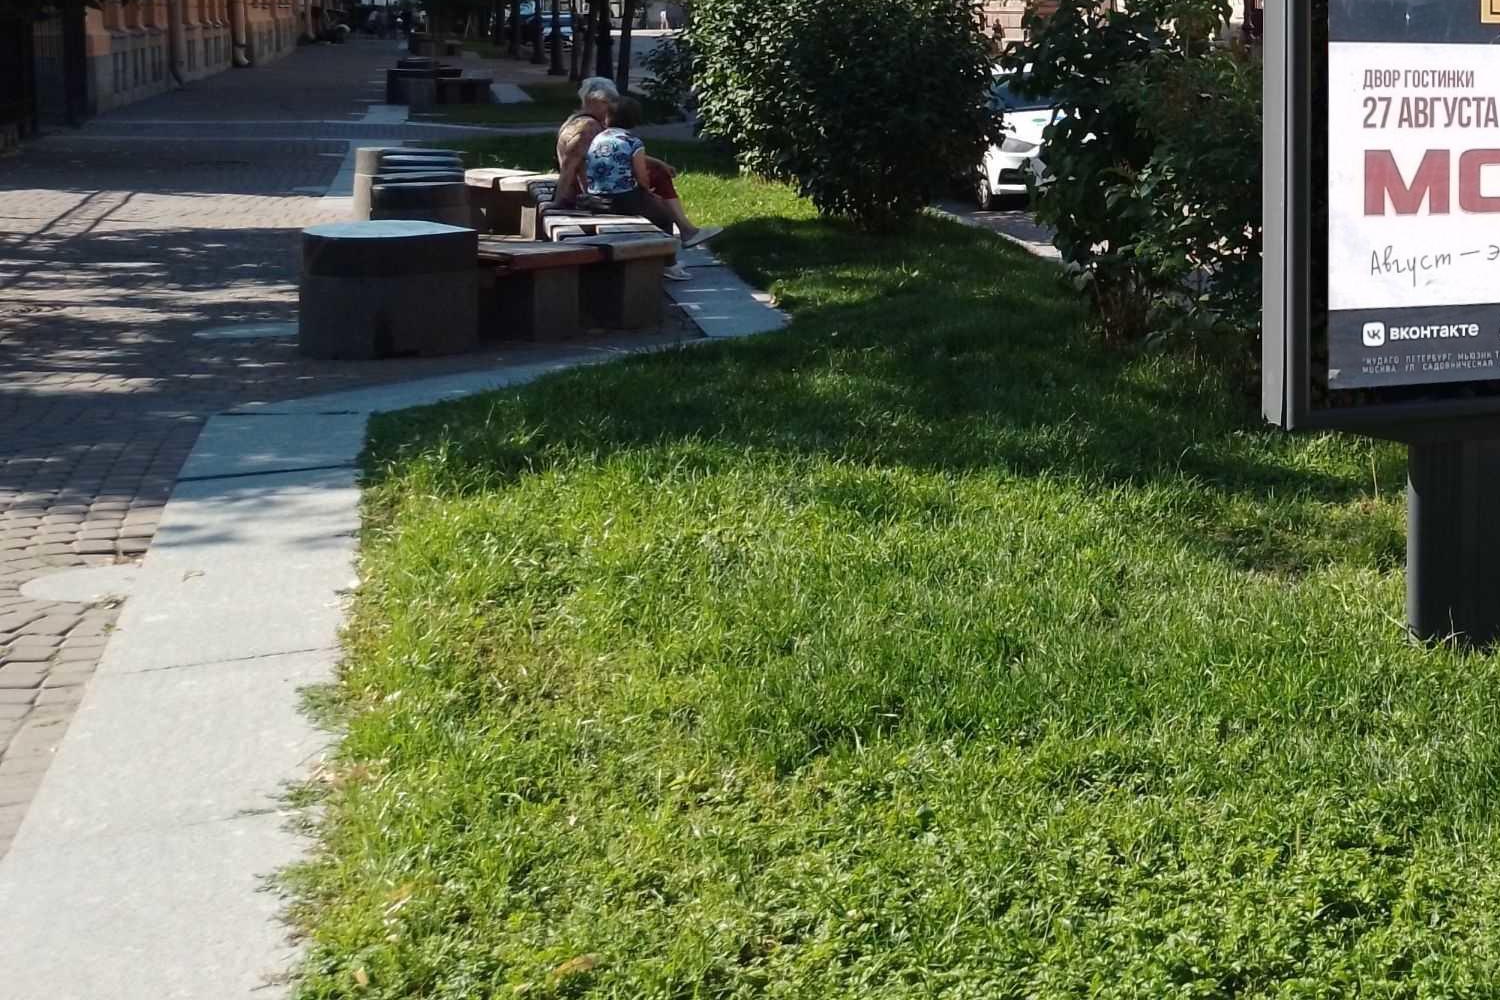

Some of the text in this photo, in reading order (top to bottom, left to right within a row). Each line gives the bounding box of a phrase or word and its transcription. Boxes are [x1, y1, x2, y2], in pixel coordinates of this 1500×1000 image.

[1363, 68, 1475, 91] ДВОР ГОСТИНКИ
[1363, 95, 1499, 129] 27 АВГУСТА
[1371, 245, 1452, 288] Август
